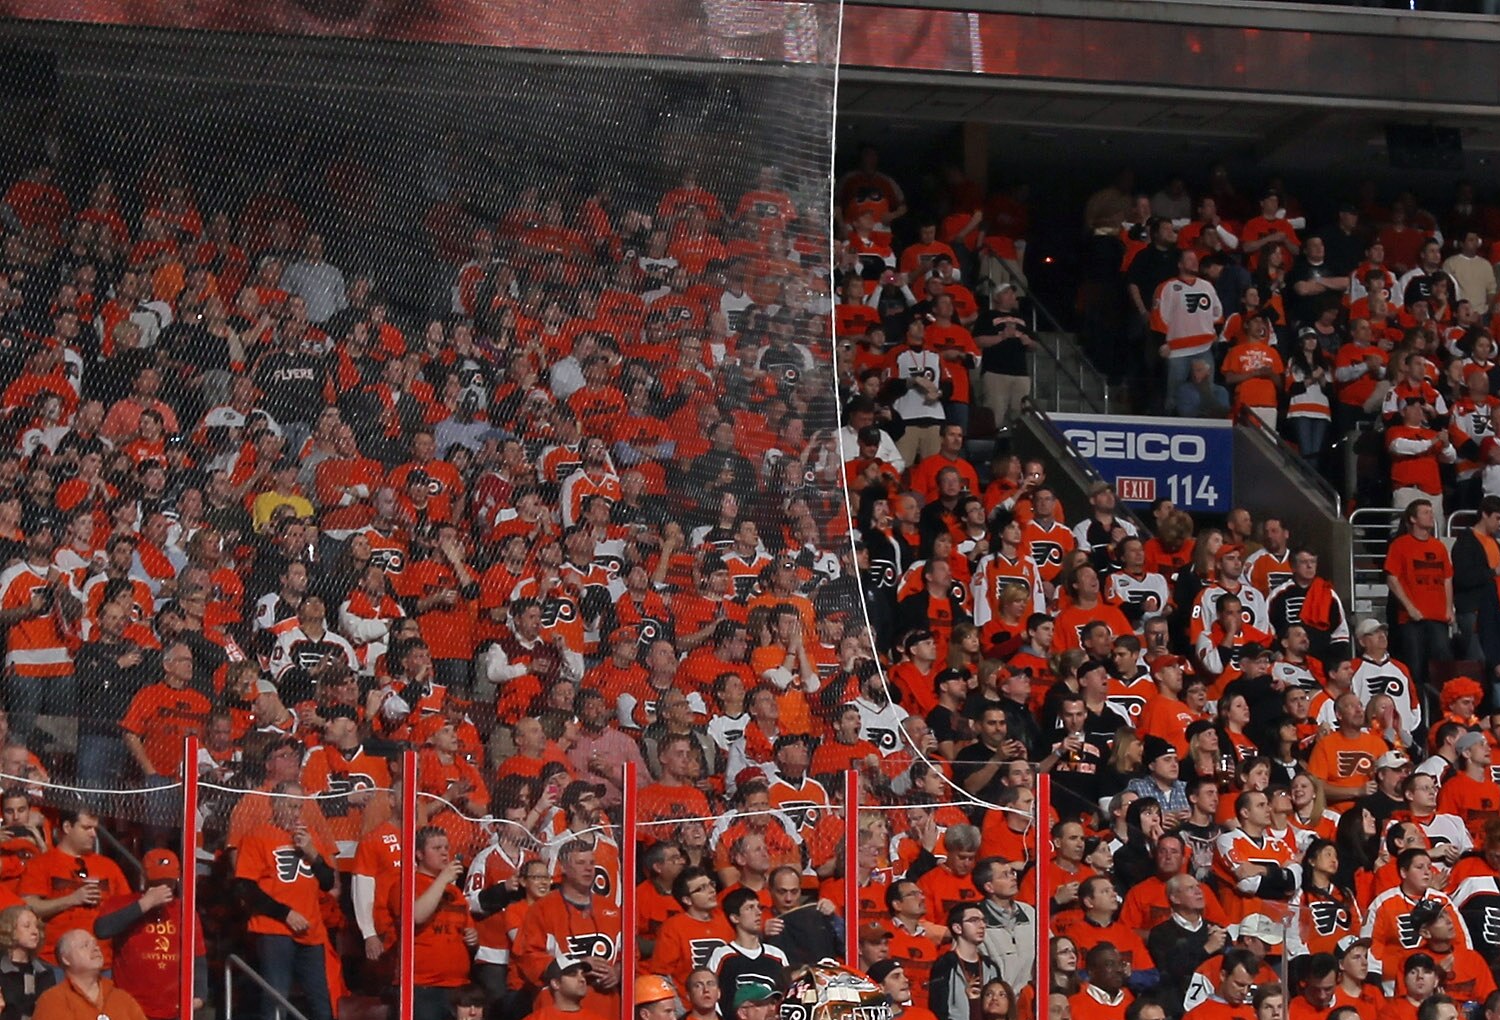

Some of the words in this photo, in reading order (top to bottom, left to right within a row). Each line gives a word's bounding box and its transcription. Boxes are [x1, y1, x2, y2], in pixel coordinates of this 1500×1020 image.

[1063, 429, 1206, 463] GEICO
[1123, 479, 1150, 500] EXIT
[1167, 474, 1219, 507] 114
[1190, 983, 1203, 1001] 7
